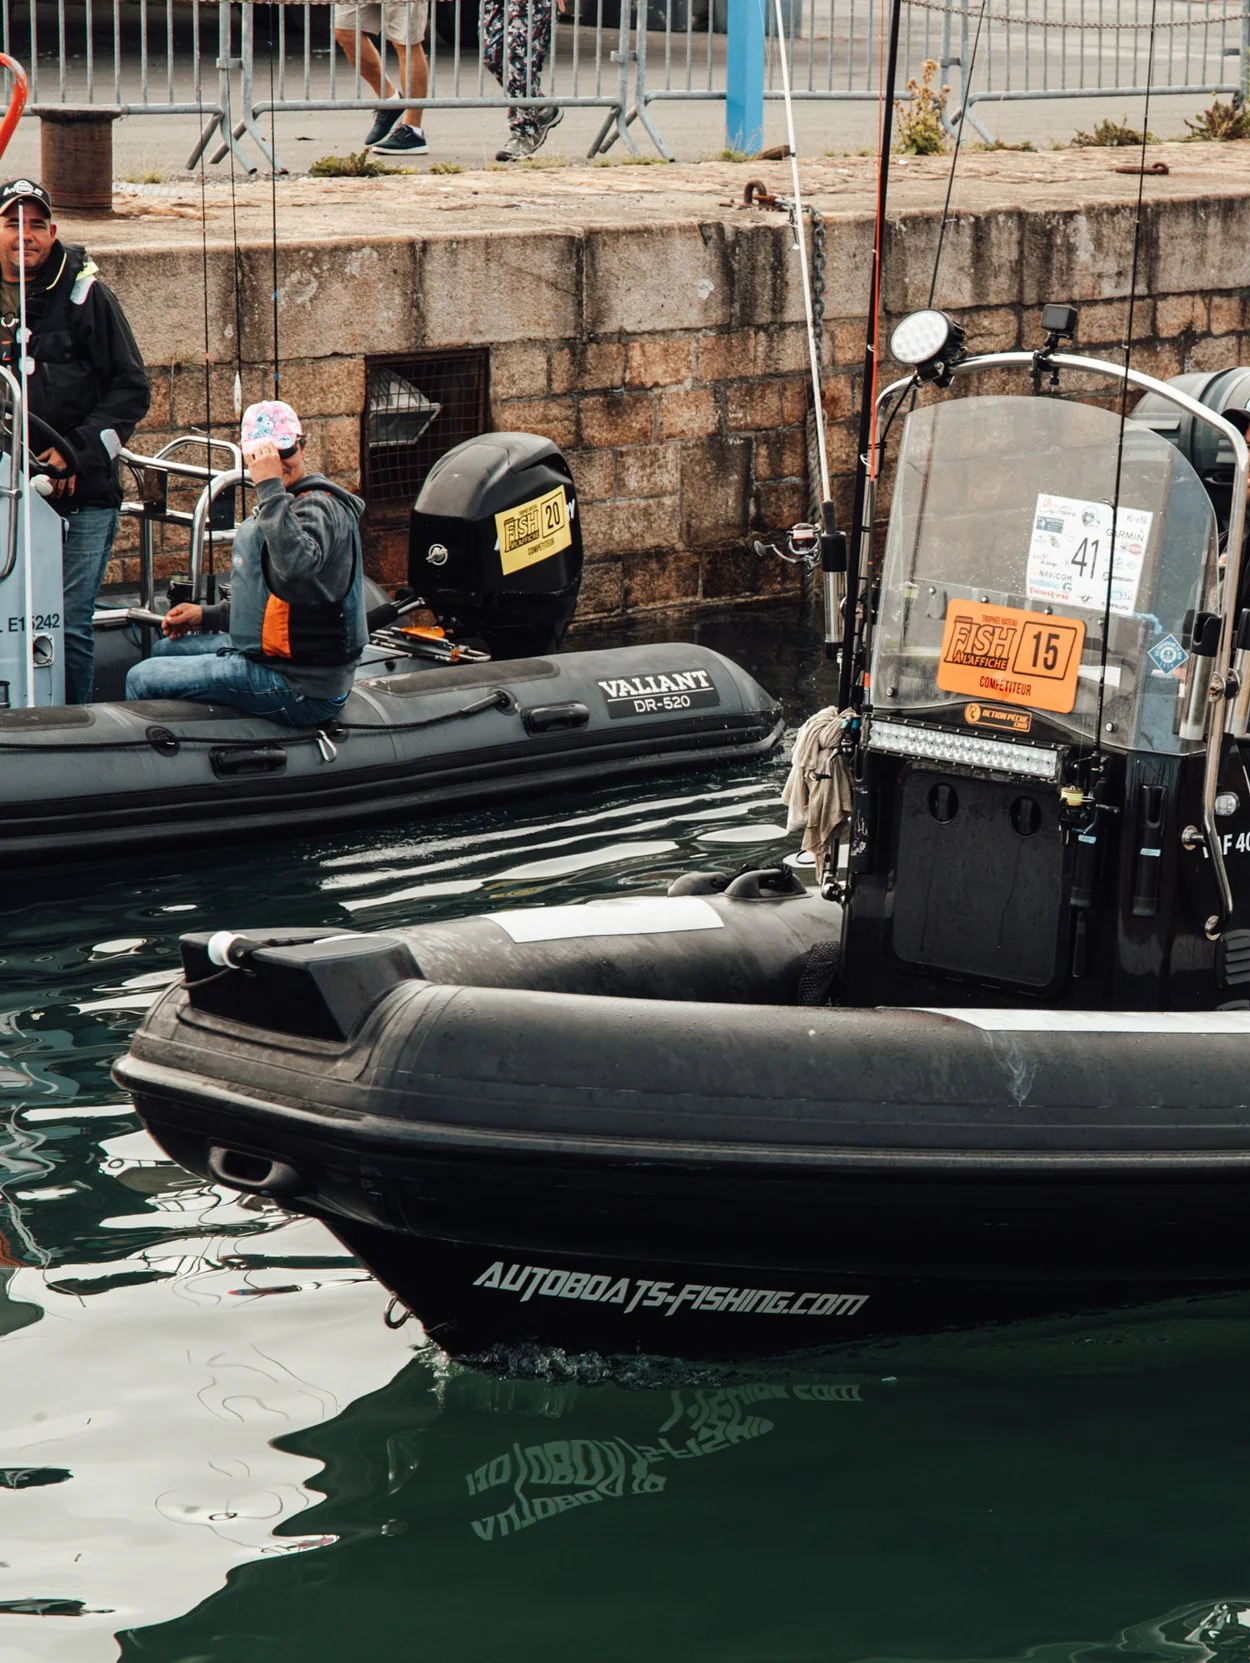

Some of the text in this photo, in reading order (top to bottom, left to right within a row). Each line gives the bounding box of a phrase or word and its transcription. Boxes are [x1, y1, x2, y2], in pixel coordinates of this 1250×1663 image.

[504, 509, 539, 553] FISH
[545, 501, 561, 529] 20
[1071, 537, 1100, 580] 41
[944, 621, 1018, 663] FISH
[962, 654, 1008, 671] L'AFFICHE
[1032, 630, 1060, 671] 15
[597, 670, 710, 698] VALIANT
[633, 694, 691, 713] DR-520
[471, 1260, 871, 1317] AUTOBOATS-FISHING.COM
